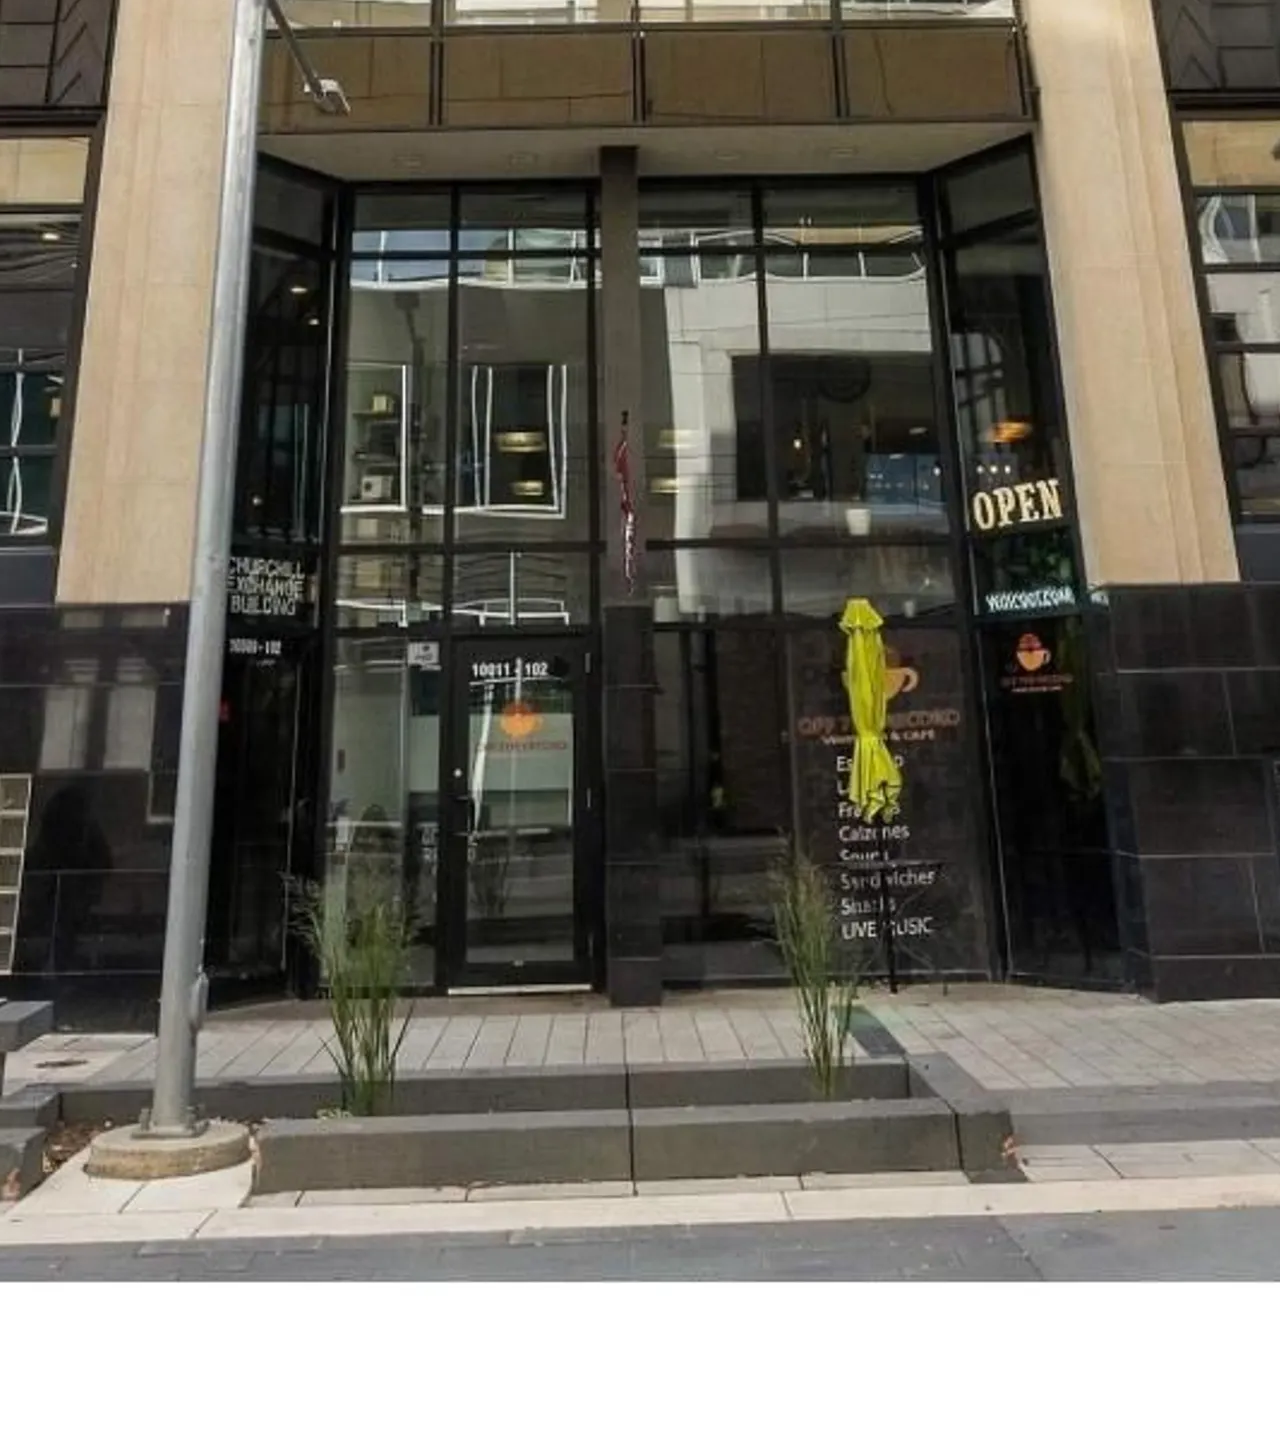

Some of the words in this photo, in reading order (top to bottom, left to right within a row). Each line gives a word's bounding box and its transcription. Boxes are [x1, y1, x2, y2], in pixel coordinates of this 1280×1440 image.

[973, 478, 1063, 530] OPEN
[231, 595, 296, 615] BUILDING
[472, 661, 510, 677] 10011
[524, 662, 549, 676] 102
[841, 921, 877, 940] LIVE
